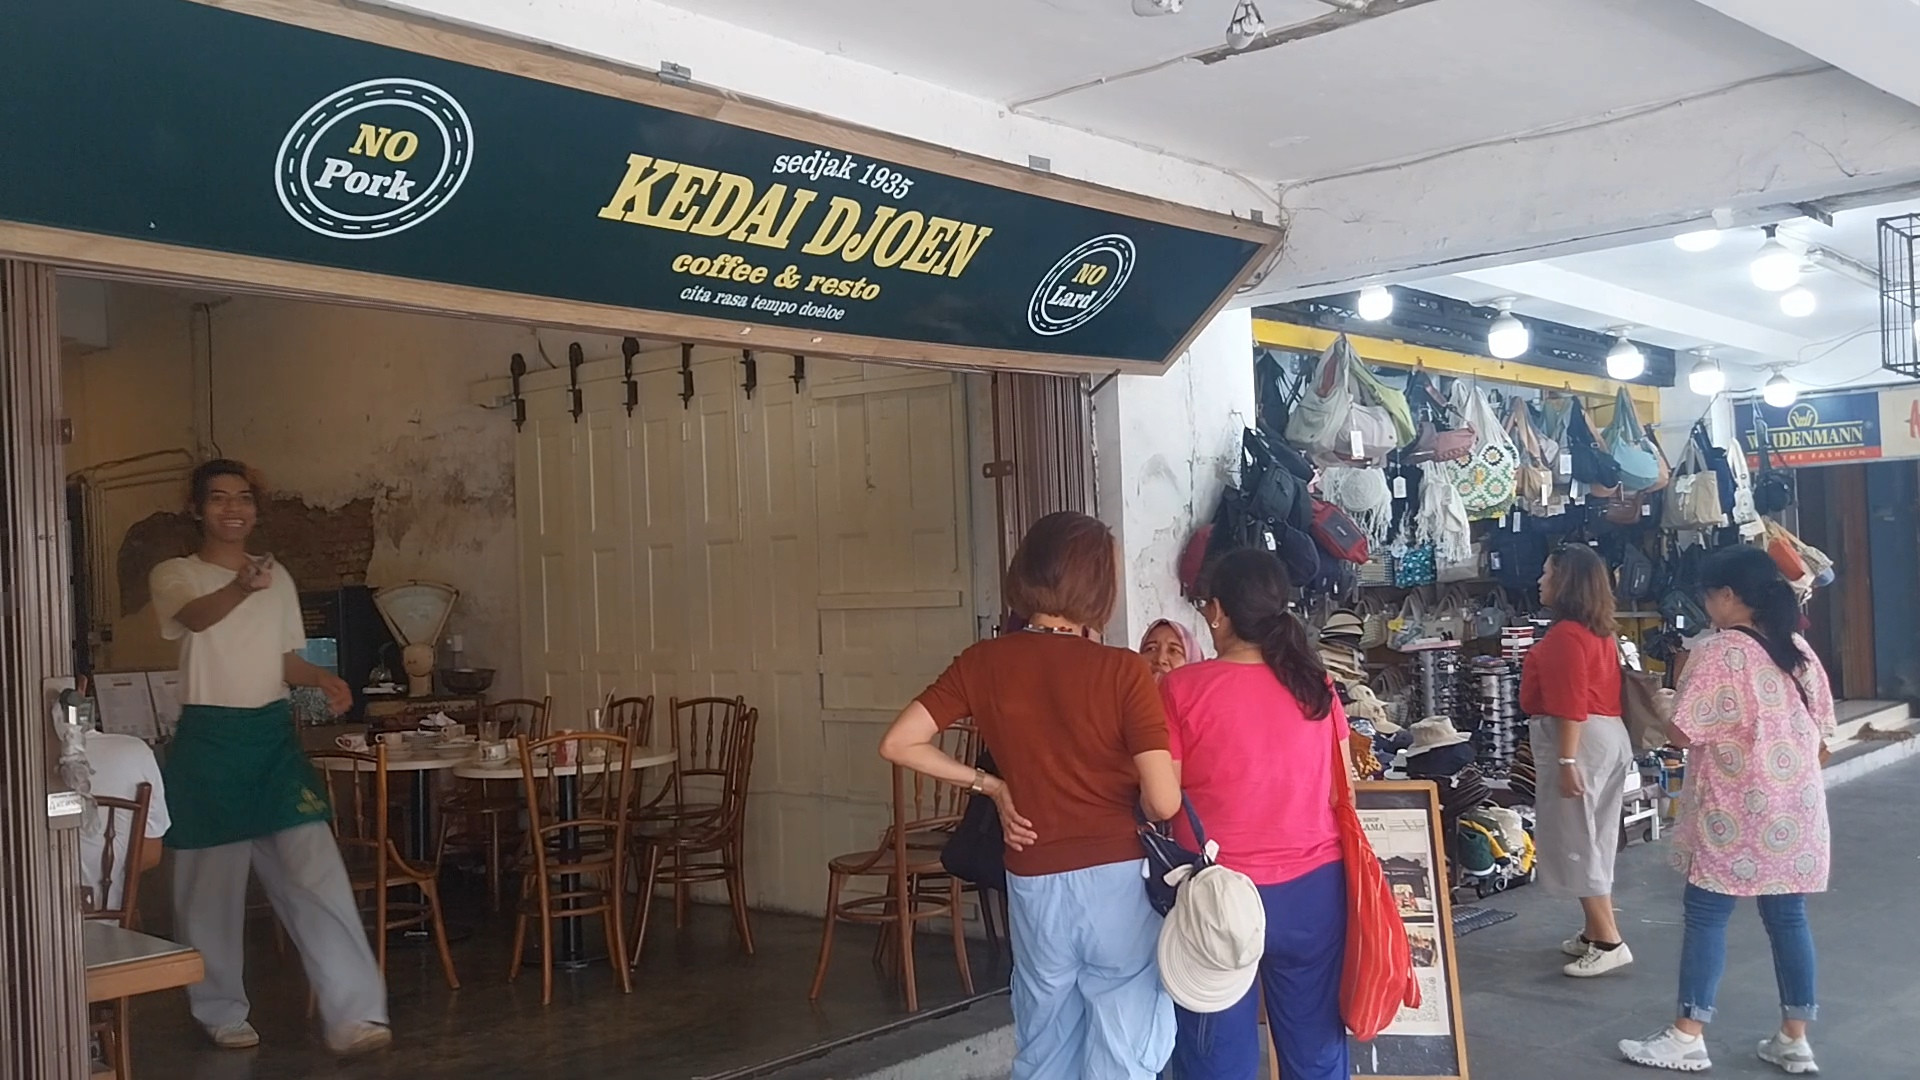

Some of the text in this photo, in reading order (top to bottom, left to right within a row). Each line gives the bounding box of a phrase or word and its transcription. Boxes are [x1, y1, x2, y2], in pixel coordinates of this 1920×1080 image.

[348, 123, 418, 162] NO
[313, 157, 416, 202] Pork
[772, 150, 915, 200] sedjak 1935
[598, 153, 994, 278] KEDAI DJOEN
[672, 253, 881, 301] coffee & resto
[1070, 262, 1108, 286] NO
[680, 285, 846, 321] cita rasa tempo doeloe
[1046, 285, 1098, 309] Lard
[1746, 426, 1864, 450] WIDENMANN
